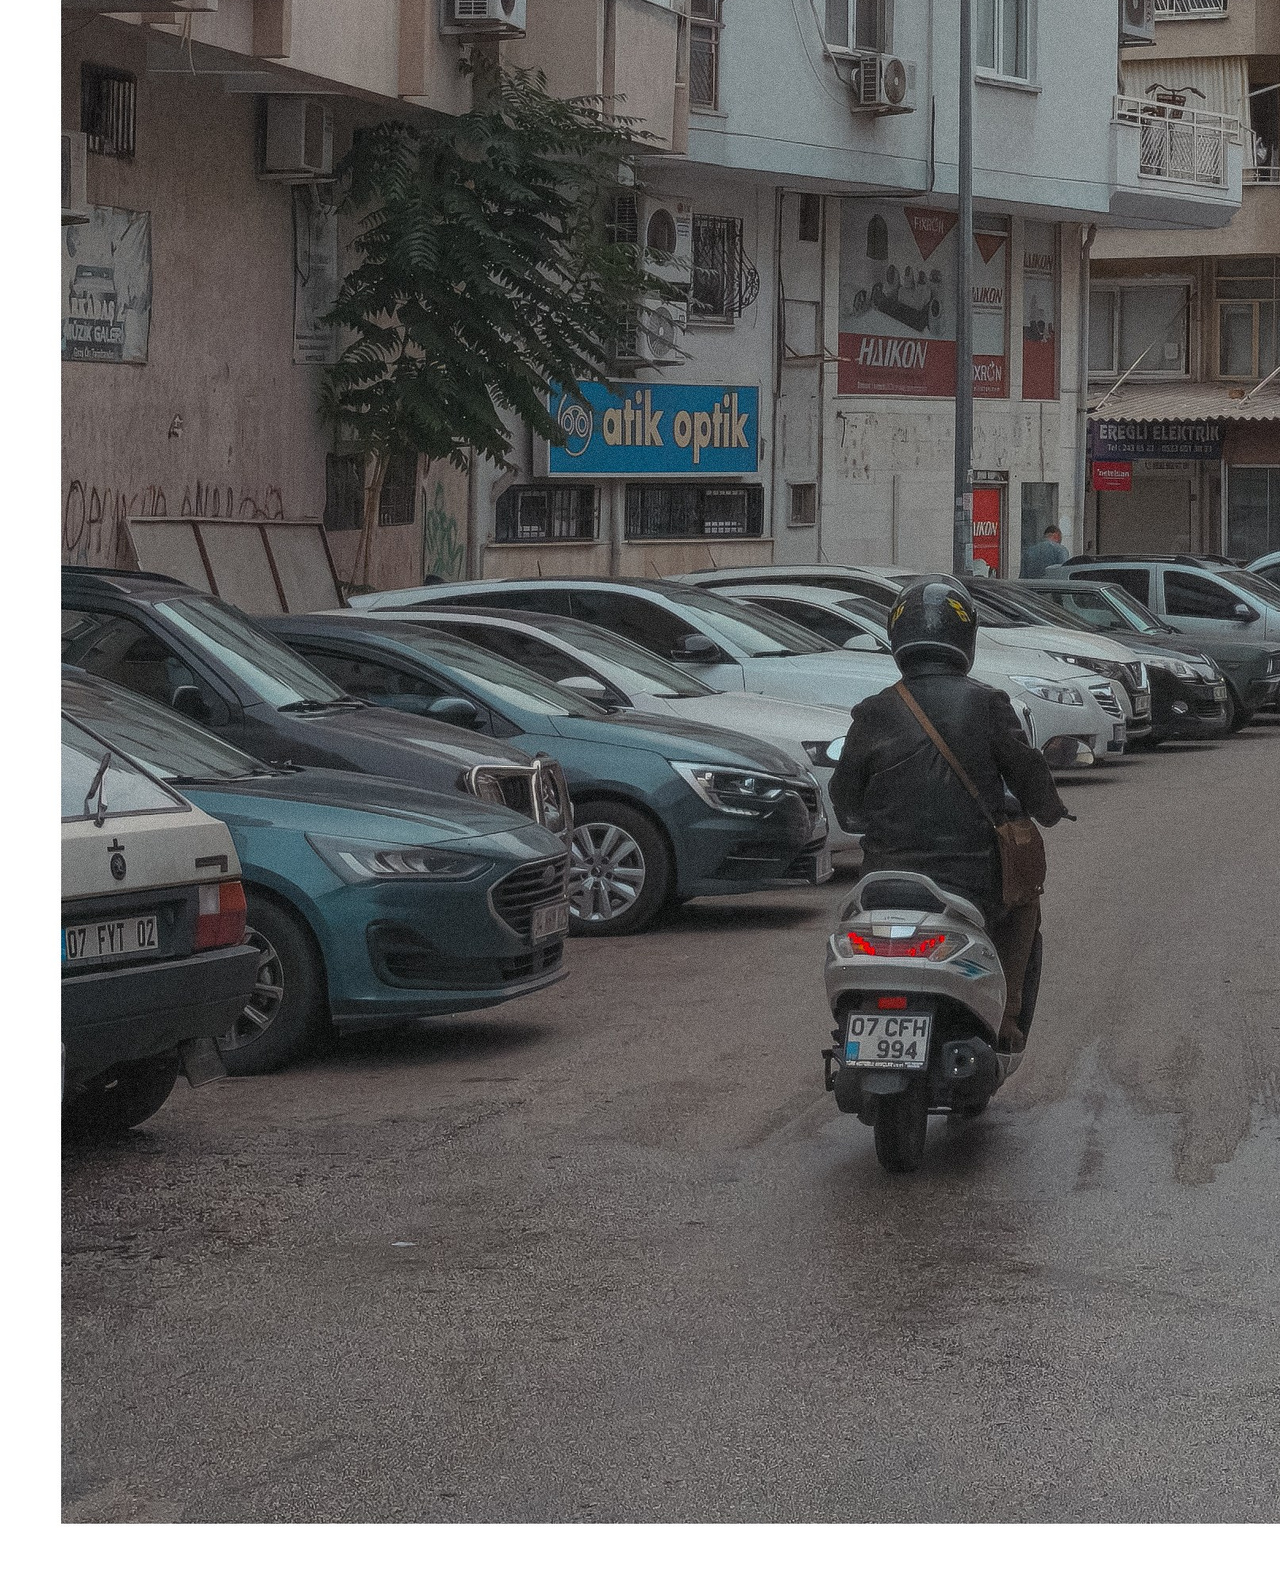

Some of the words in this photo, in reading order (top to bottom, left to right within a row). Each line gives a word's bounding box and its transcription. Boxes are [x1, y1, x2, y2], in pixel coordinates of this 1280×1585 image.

[603, 389, 664, 447] atik
[674, 392, 750, 465] optik
[68, 928, 87, 958] 07
[98, 923, 124, 954] FYT
[137, 919, 156, 947] 02
[851, 1018, 879, 1036] 07
[885, 1018, 927, 1037] CFH
[877, 1040, 917, 1059] 994
